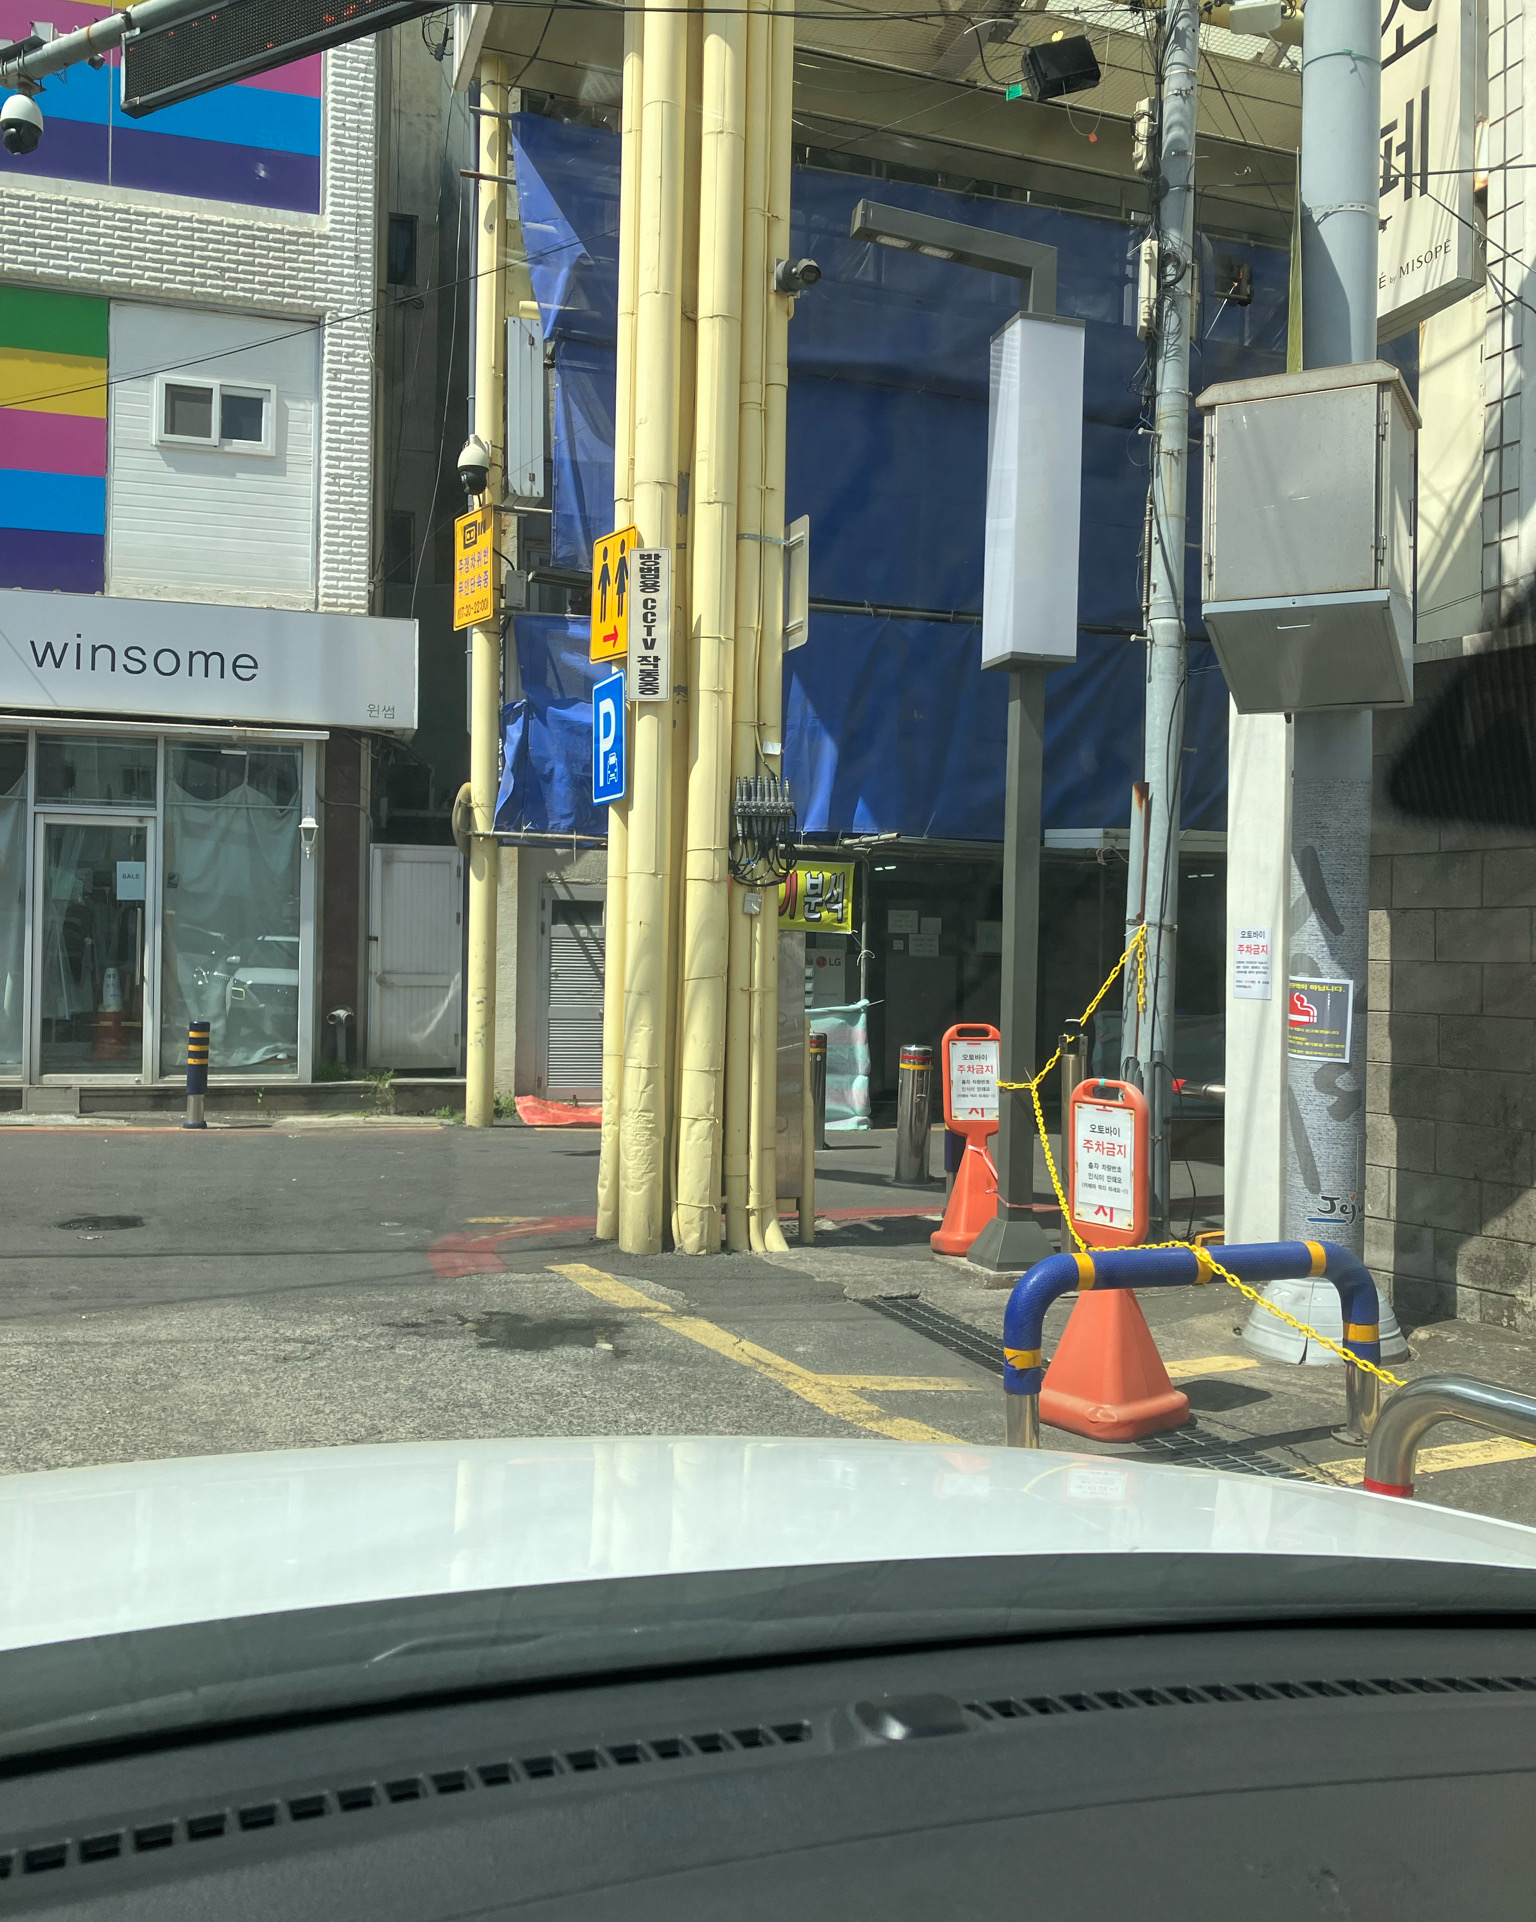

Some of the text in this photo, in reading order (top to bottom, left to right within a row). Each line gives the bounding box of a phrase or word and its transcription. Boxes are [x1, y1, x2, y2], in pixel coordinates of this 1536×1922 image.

[1389, 275, 1397, 284] by
[1399, 238, 1452, 279] MISOPÉ
[458, 546, 489, 576] 주정차위반
[458, 570, 489, 600] 무인단속중
[636, 553, 661, 696] 방범용 CCTV 작동중
[29, 633, 259, 682] winsome
[366, 703, 396, 720] 윈썸
[803, 870, 846, 924] 분식
[1240, 930, 1266, 939] 오토바이
[1237, 944, 1268, 956] 주차금지
[828, 957, 842, 967] LG
[957, 1064, 994, 1074] 주차금지
[1089, 1124, 1120, 1138] 오토바이
[1082, 1138, 1127, 1159] 주차금지
[1088, 1162, 1122, 1174] 출차 차량번호
[1088, 1172, 1105, 1182] 인식이
